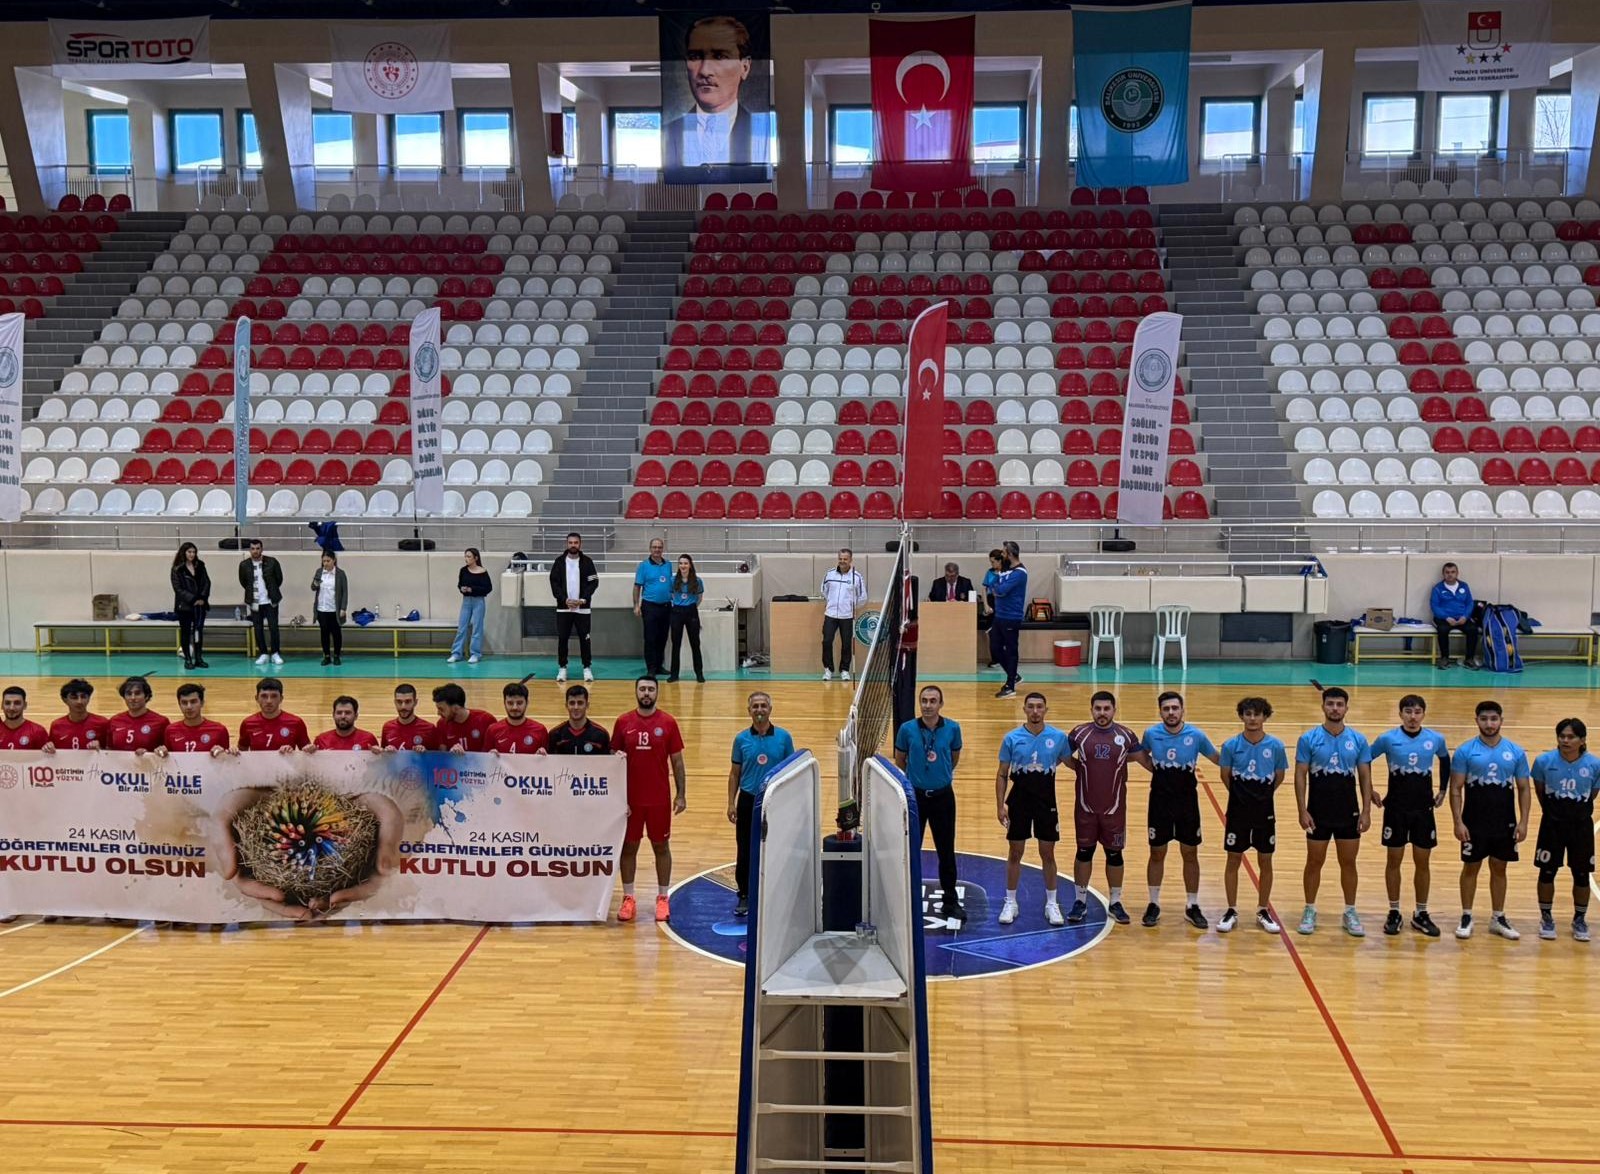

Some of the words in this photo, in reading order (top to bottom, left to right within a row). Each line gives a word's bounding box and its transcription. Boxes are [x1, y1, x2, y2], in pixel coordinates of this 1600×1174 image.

[126, 730, 134, 743] 5
[266, 734, 273, 747] 7
[638, 731, 649, 746] 13
[1094, 743, 1110, 759] 12
[1166, 747, 1176, 760] 6
[1487, 762, 1498, 777] 2
[101, 772, 149, 786] OKUL
[165, 772, 202, 788] AİLE
[504, 775, 553, 789] OKUL
[570, 773, 608, 789] AİLE
[1560, 778, 1576, 791] 10
[69, 828, 85, 839] 24
[90, 828, 136, 841] KASIM
[469, 832, 486, 843] 24
[491, 831, 539, 843] KASIM
[1383, 826, 1392, 840] 9
[0, 838, 120, 854] ÖĞRETMENLER
[125, 842, 206, 857] GÜNÜNÜZ
[399, 841, 523, 856] ÖĞRETMENLER
[528, 844, 613, 857] GÜNÜNÜZ
[1462, 842, 1472, 856] 2
[1536, 848, 1551, 863] 10
[0, 855, 96, 873] KUTLU
[105, 857, 206, 878] OLSUN
[400, 858, 496, 877] KUTLU
[506, 860, 613, 878] OLSUN
